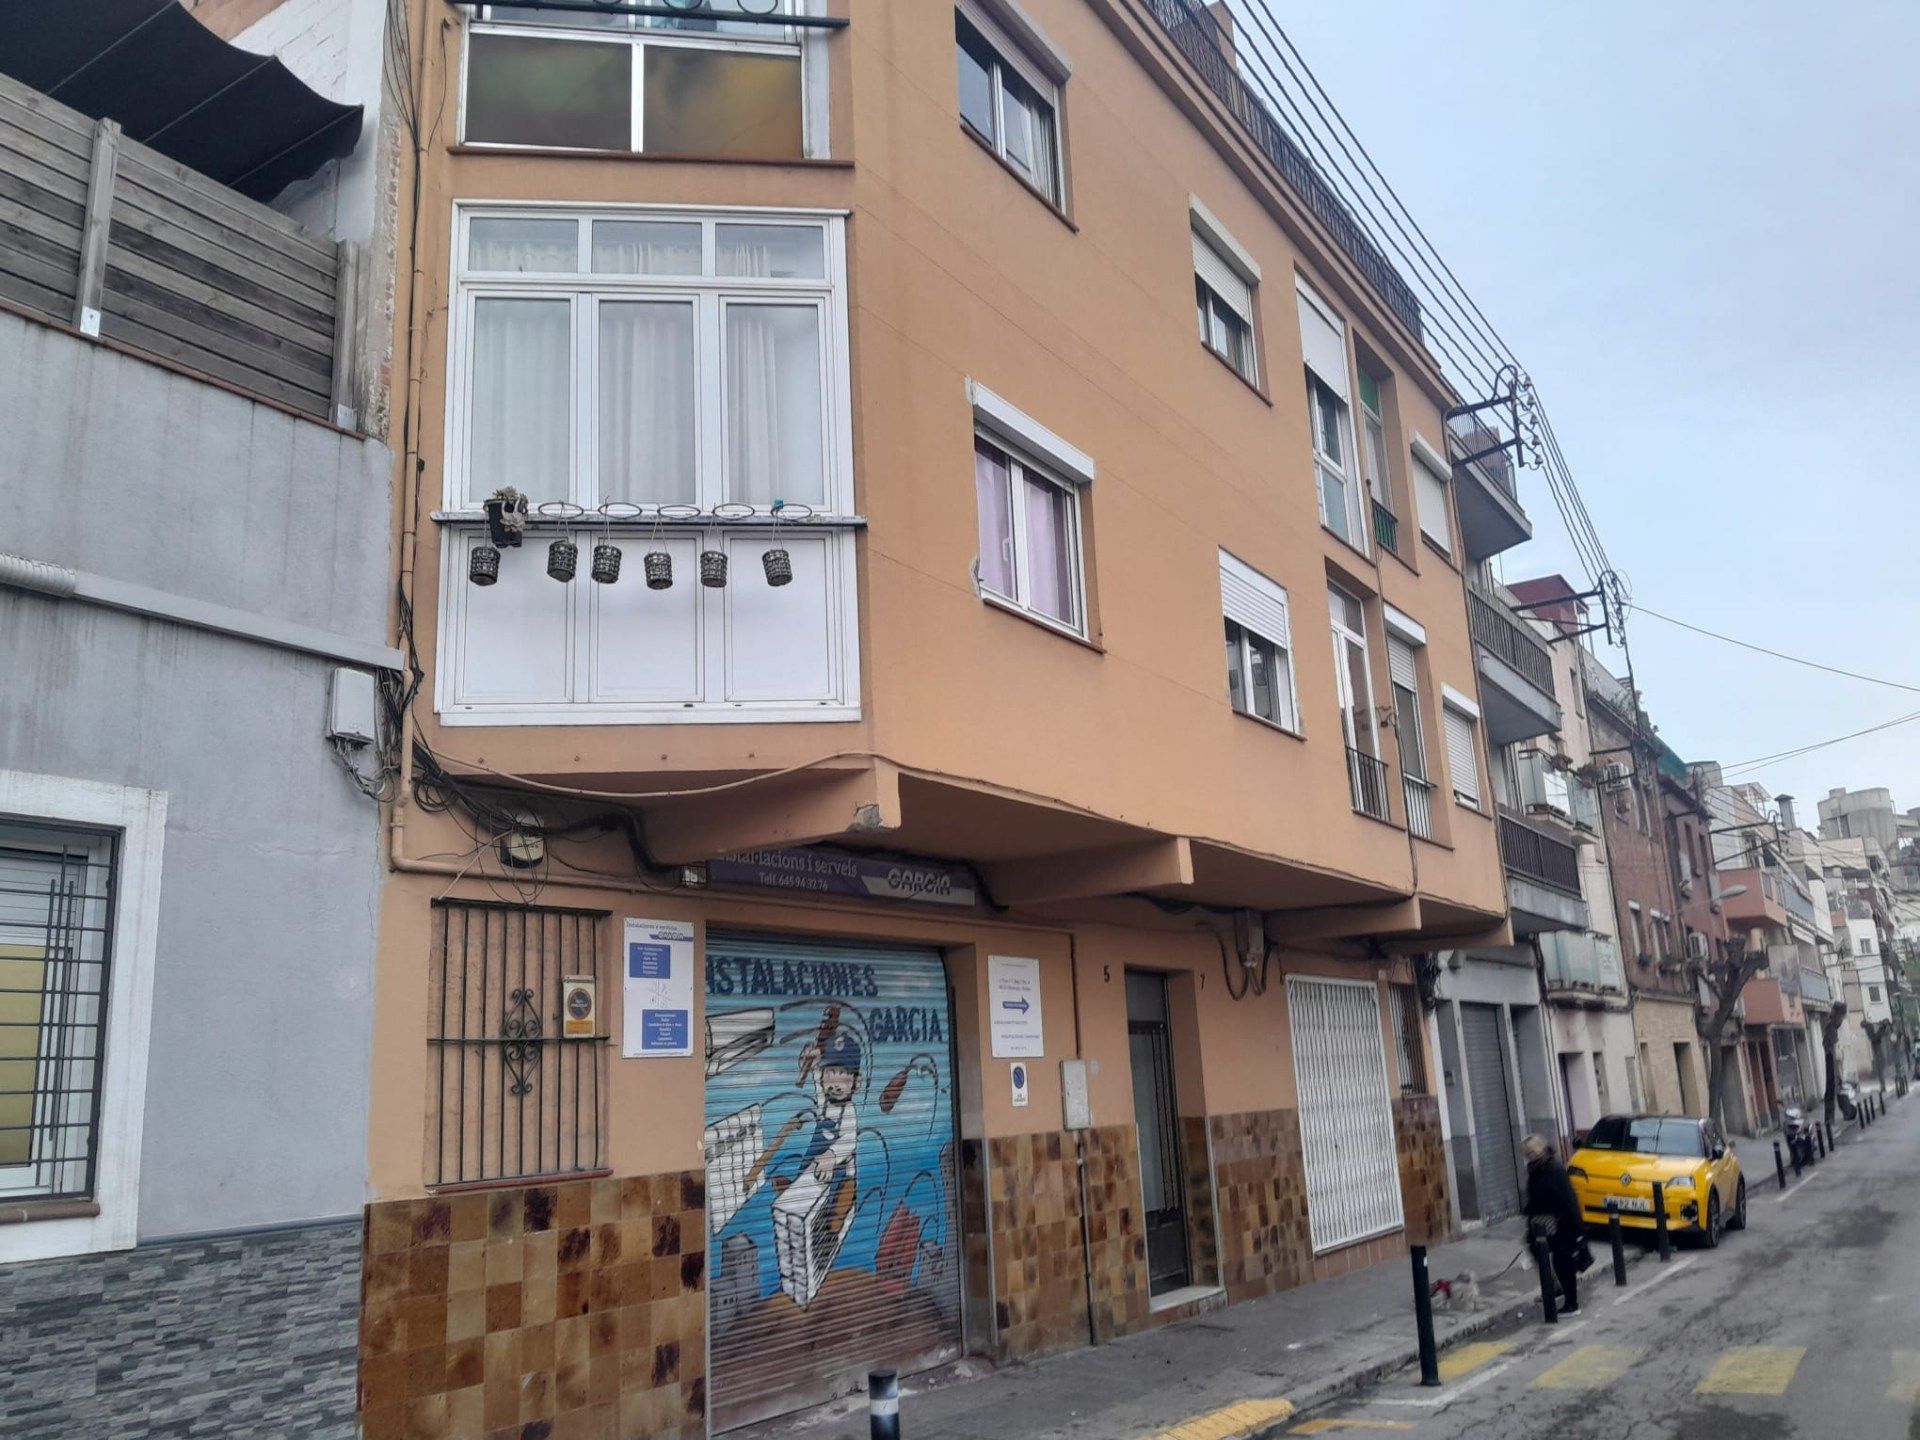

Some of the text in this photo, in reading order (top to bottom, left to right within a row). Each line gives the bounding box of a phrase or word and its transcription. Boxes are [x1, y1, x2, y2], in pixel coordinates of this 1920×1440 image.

[887, 867, 951, 896] GARCIA
[1103, 965, 1111, 983] 5
[1199, 971, 1206, 990] 7
[869, 1005, 943, 1043] GARCIA
